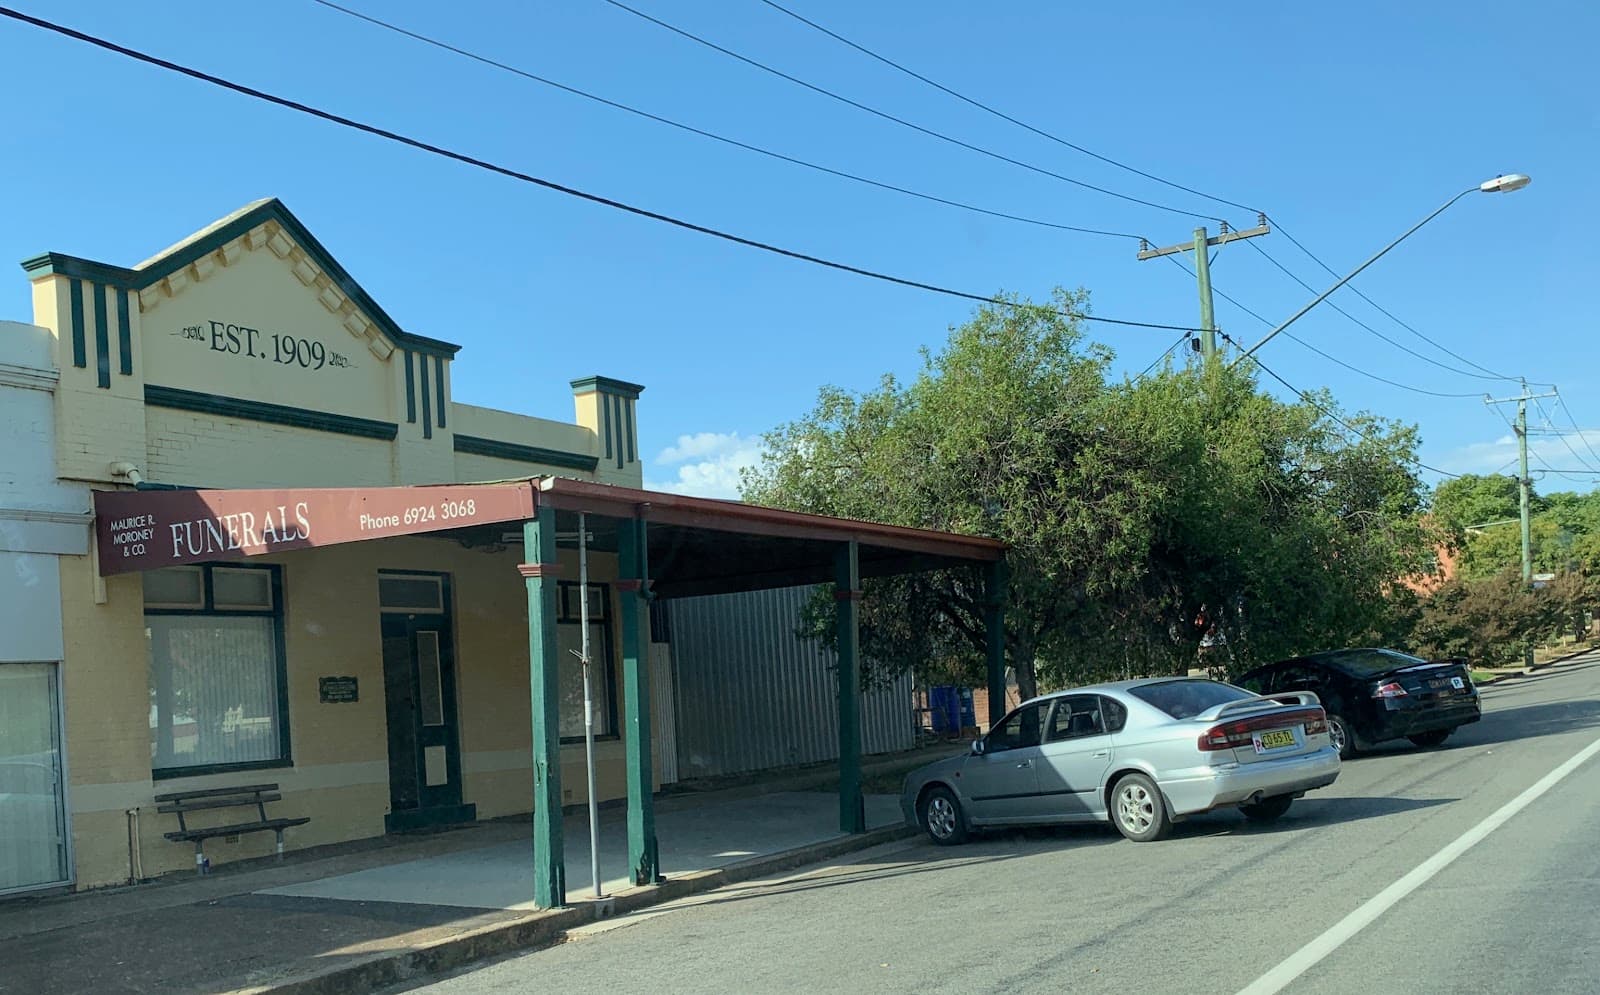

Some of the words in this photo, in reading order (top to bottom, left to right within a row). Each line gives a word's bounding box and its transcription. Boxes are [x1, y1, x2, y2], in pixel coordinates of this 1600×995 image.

[208, 320, 266, 359] EST.
[272, 334, 325, 370] 1909
[111, 516, 146, 531] MAURICE
[360, 513, 400, 530] Phone
[404, 505, 436, 525] 6924
[441, 499, 476, 520] 3068
[113, 527, 154, 545] MORONEY
[169, 501, 311, 558] FUNERALS
[123, 546, 130, 557] &
